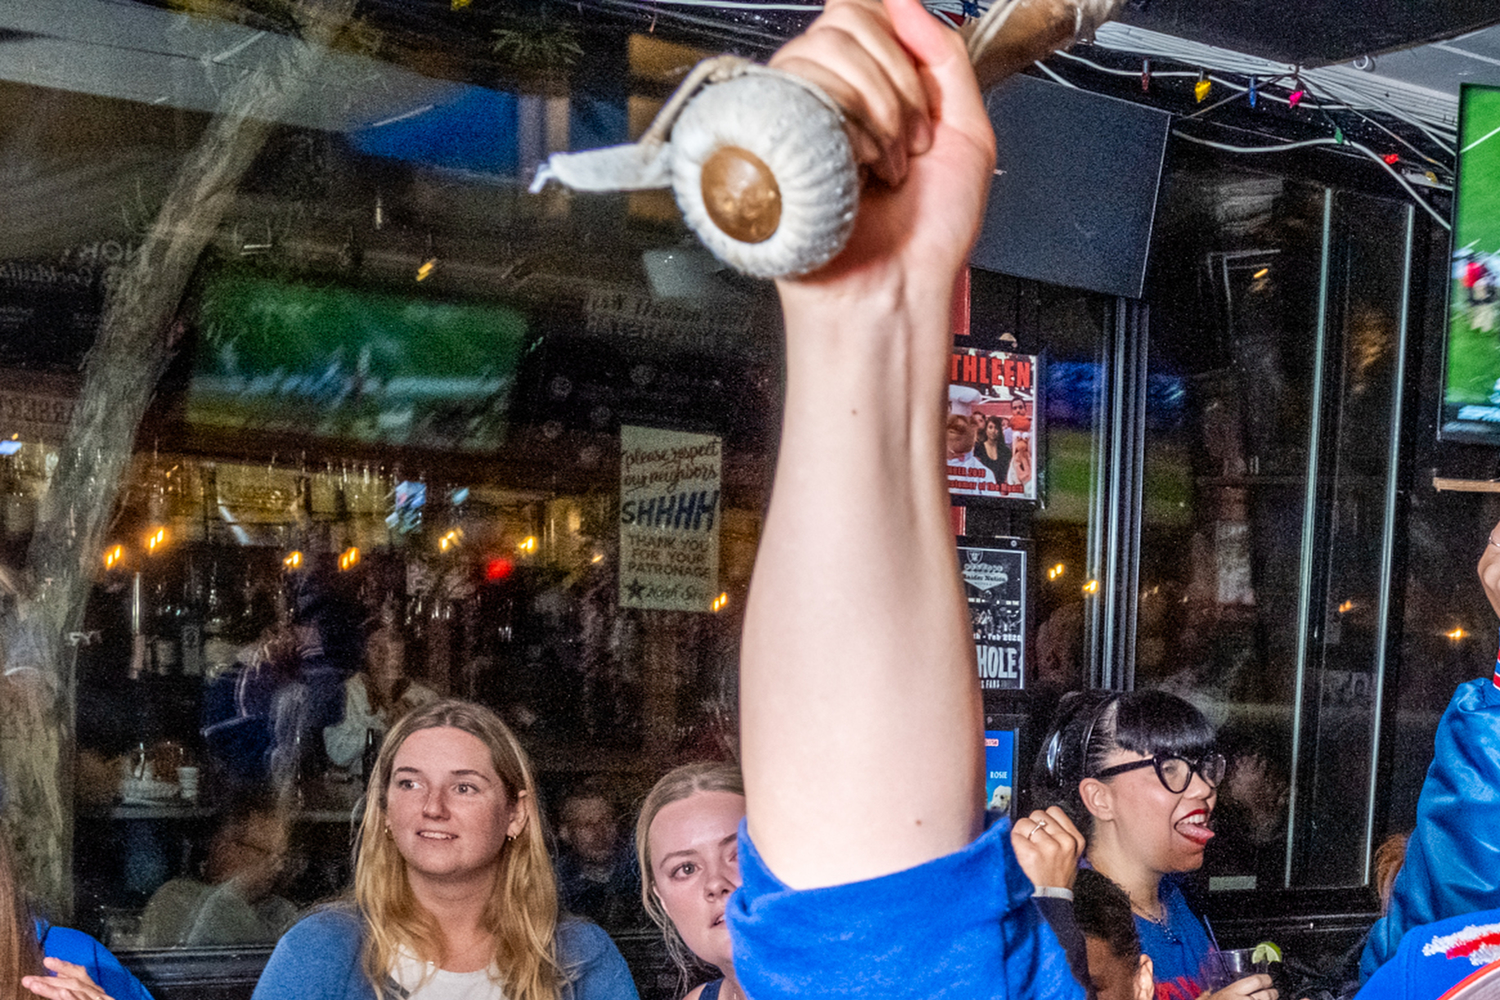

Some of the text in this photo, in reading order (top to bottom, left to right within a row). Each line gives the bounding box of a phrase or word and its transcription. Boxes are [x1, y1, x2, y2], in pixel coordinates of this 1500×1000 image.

[951, 353, 1031, 388] THLEEN
[621, 490, 721, 532] SHHHH
[963, 573, 983, 582] aider
[976, 644, 1018, 679] HOLE
[989, 770, 1008, 780] ROSIE
